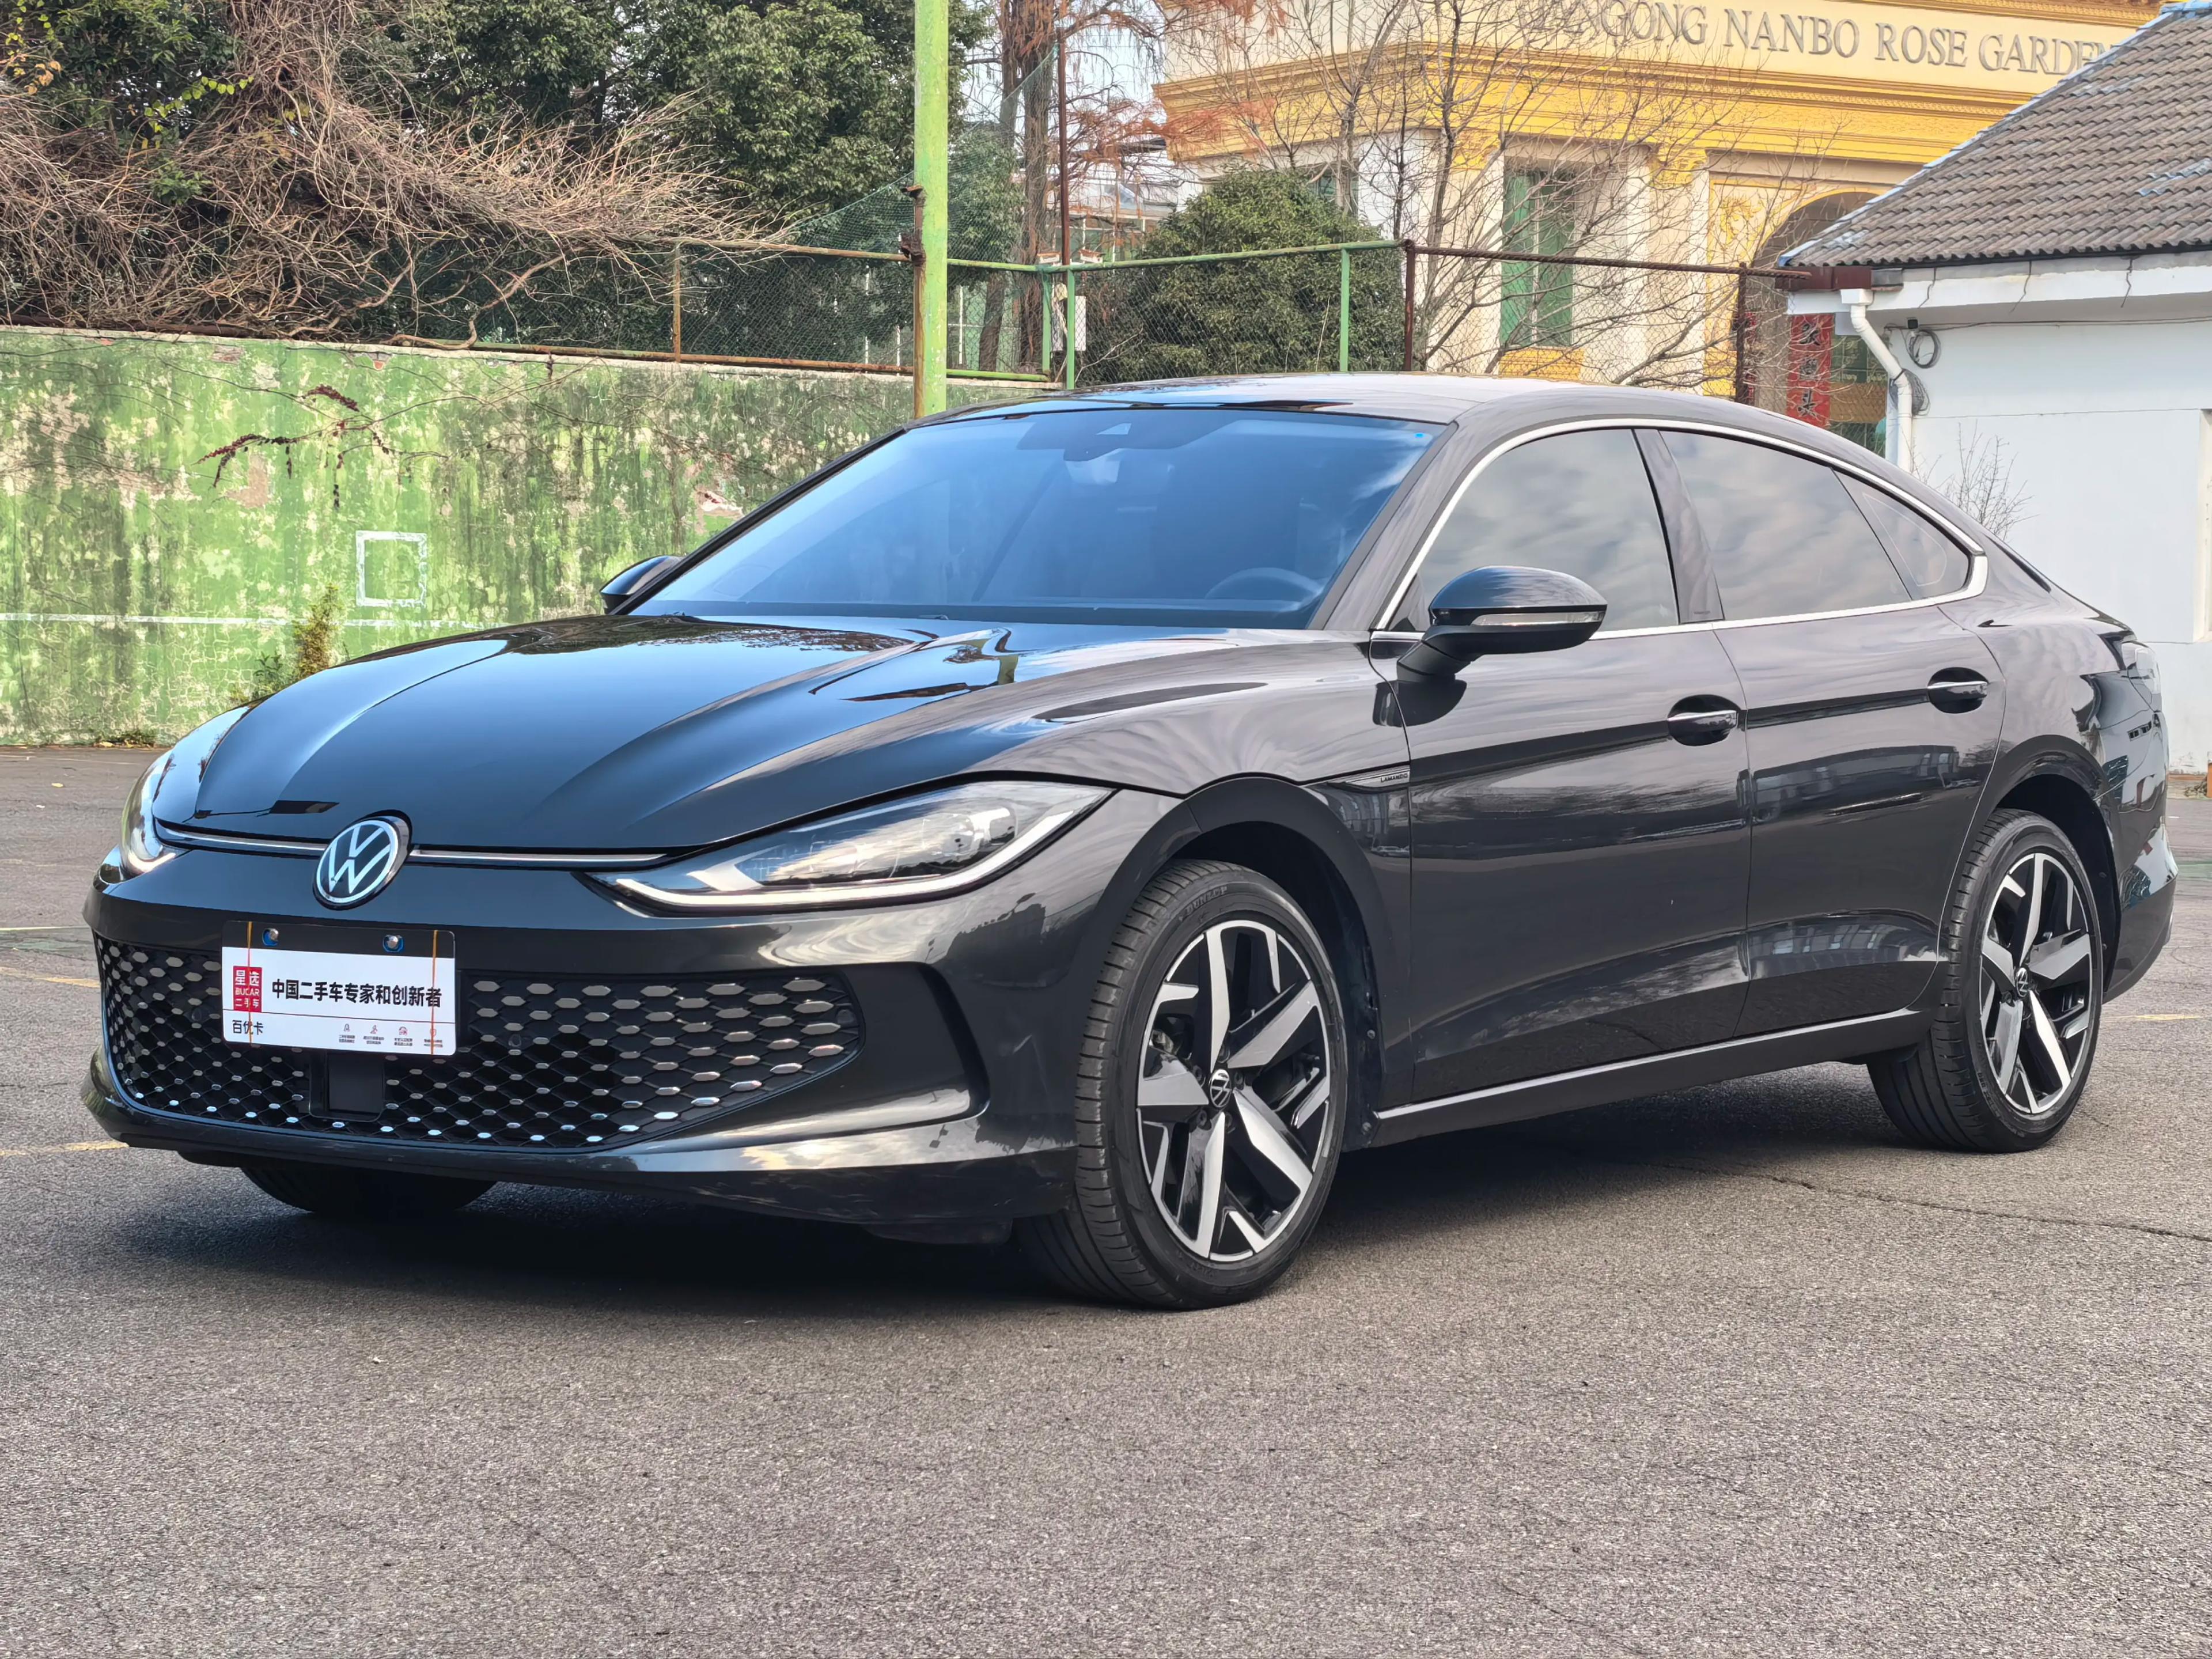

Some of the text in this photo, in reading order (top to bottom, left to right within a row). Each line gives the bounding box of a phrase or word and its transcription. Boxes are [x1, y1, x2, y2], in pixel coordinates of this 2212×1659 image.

[1723, 8, 1860, 58] NANBO
[1874, 22, 1968, 67] ROSE
[234, 969, 260, 986] 星选
[235, 987, 260, 997] BUCAR
[271, 978, 442, 1008] 中国二手车专家和创新者
[235, 997, 260, 1009] 二手车
[232, 1020, 264, 1035] 百优卡
